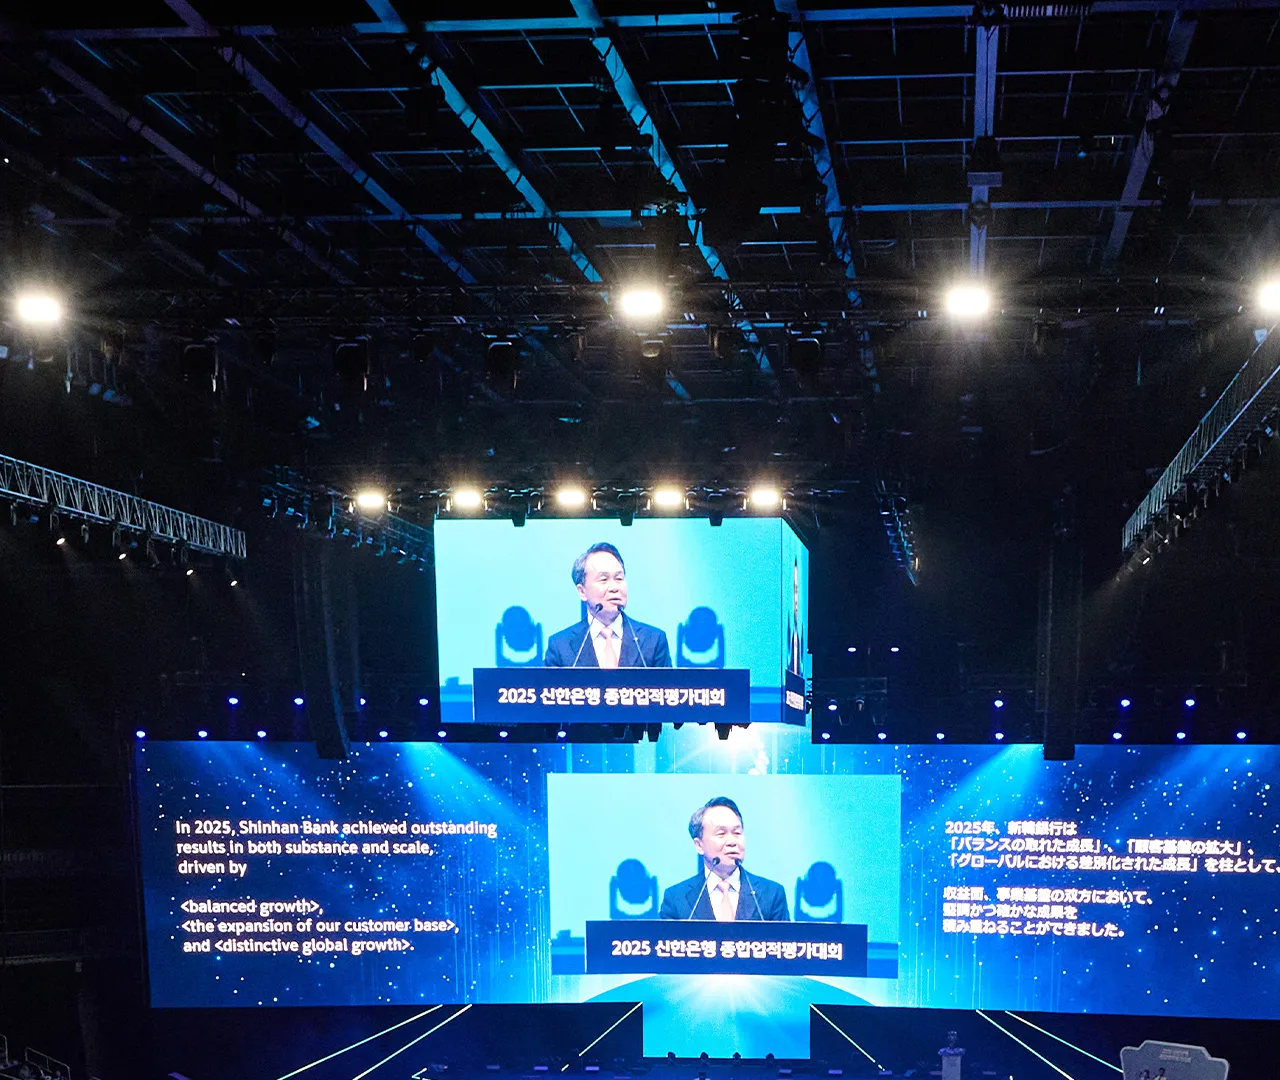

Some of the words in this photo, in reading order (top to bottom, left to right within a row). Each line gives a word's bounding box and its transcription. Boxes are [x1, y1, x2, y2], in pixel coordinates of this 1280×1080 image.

[498, 687, 536, 704] 2025
[540, 687, 600, 705] 신한은행
[604, 688, 725, 707] 종합업적평가대회
[176, 820, 190, 834] In
[194, 820, 236, 837] 2025,
[239, 820, 299, 834] Shinhan
[302, 820, 339, 835] Bank
[342, 820, 407, 834] achieved
[411, 820, 498, 839] outstanding
[176, 840, 226, 854] results
[229, 840, 244, 854] in
[248, 840, 282, 854] both
[285, 840, 358, 854] substance
[362, 840, 389, 854] and
[393, 840, 434, 856] scale,
[178, 860, 225, 874] driven
[229, 860, 247, 877] by
[180, 899, 256, 913] <balanced
[260, 899, 323, 917] growth>,
[181, 919, 214, 932] <the
[217, 919, 293, 936] expansion
[296, 918, 312, 932] of
[316, 920, 341, 932] our
[344, 919, 410, 932] customer
[414, 918, 459, 934] base>,
[183, 939, 211, 952] and
[215, 938, 299, 952] <distinctive
[302, 938, 348, 956] global
[351, 937, 415, 956] growth>.
[611, 940, 651, 956] 2025
[655, 941, 716, 958] 신한은행
[720, 941, 842, 961] 종합업적평가대회
